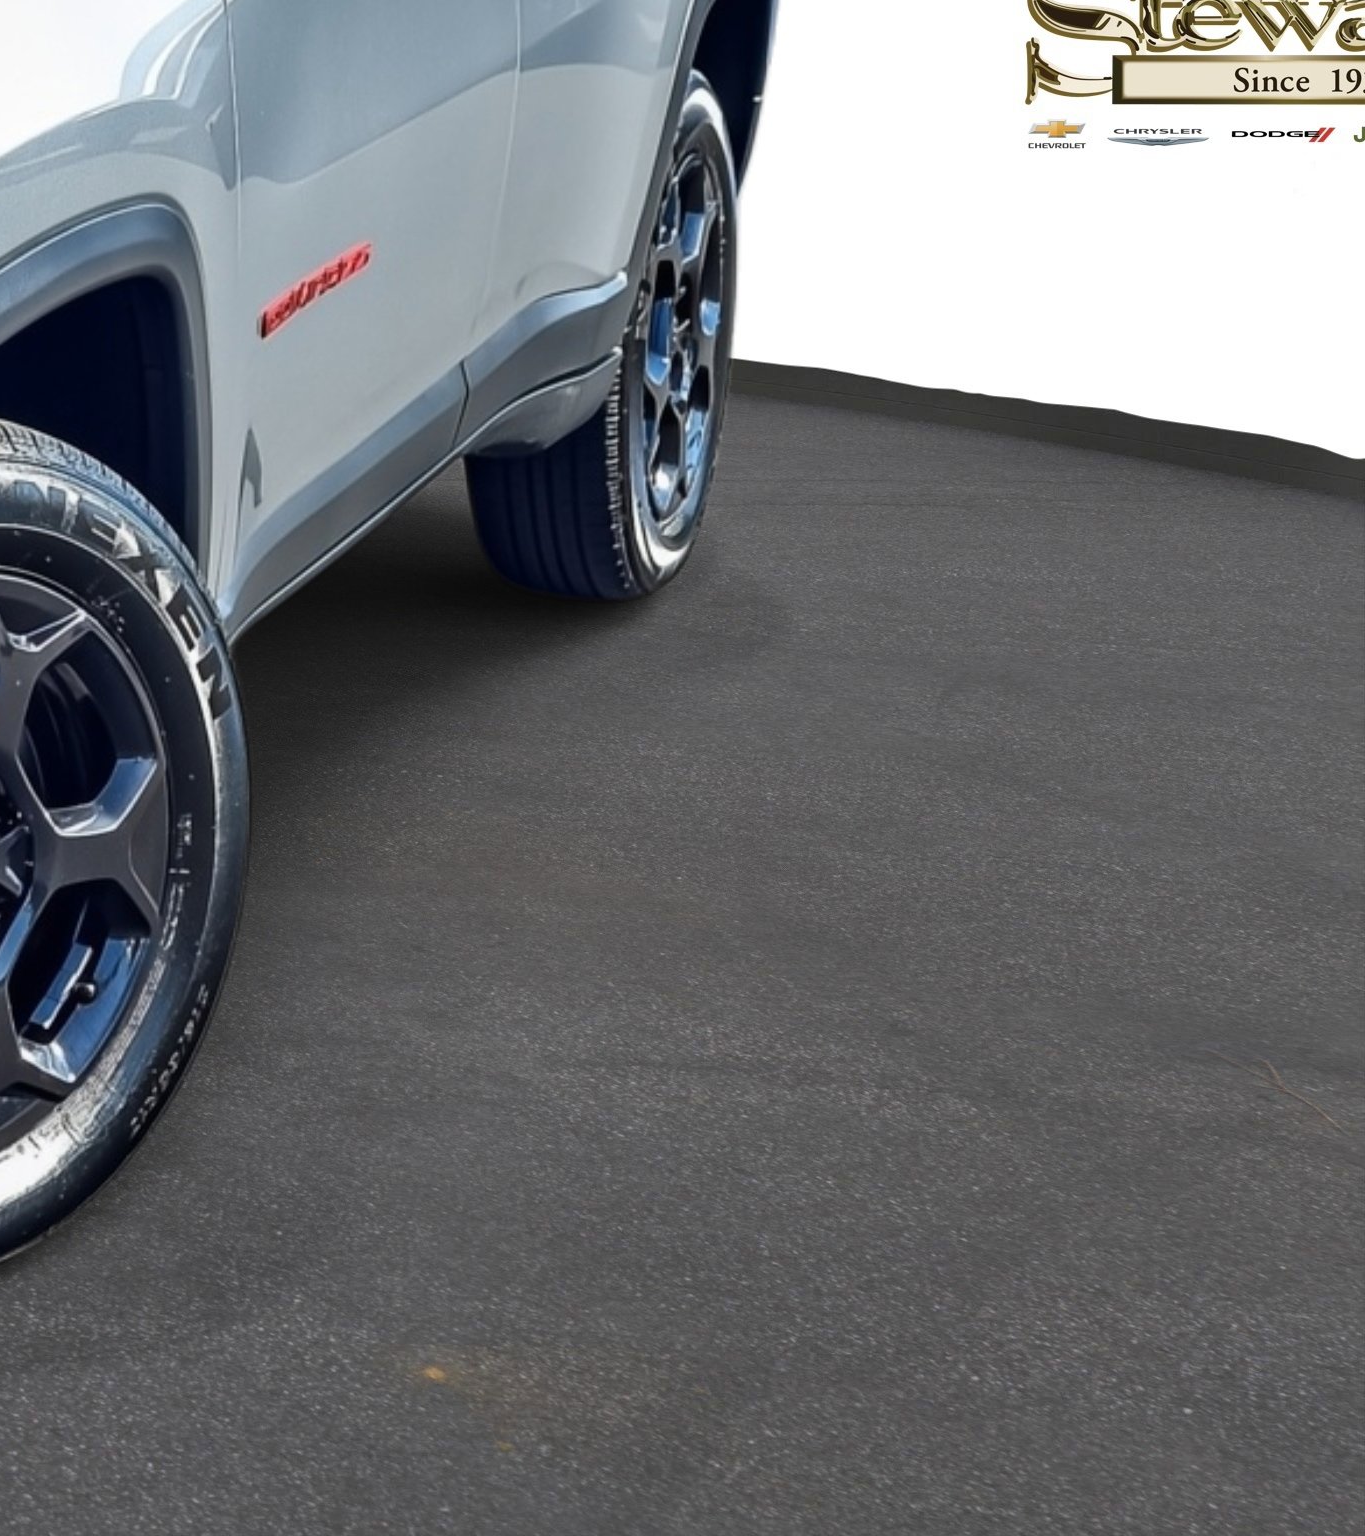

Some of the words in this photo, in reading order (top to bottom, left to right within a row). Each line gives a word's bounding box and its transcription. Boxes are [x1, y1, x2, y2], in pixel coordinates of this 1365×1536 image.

[1233, 67, 1310, 93] Since
[1330, 68, 1365, 95] 19
[1231, 130, 1320, 138] DODGE
[13, 478, 233, 722] NEXEN
